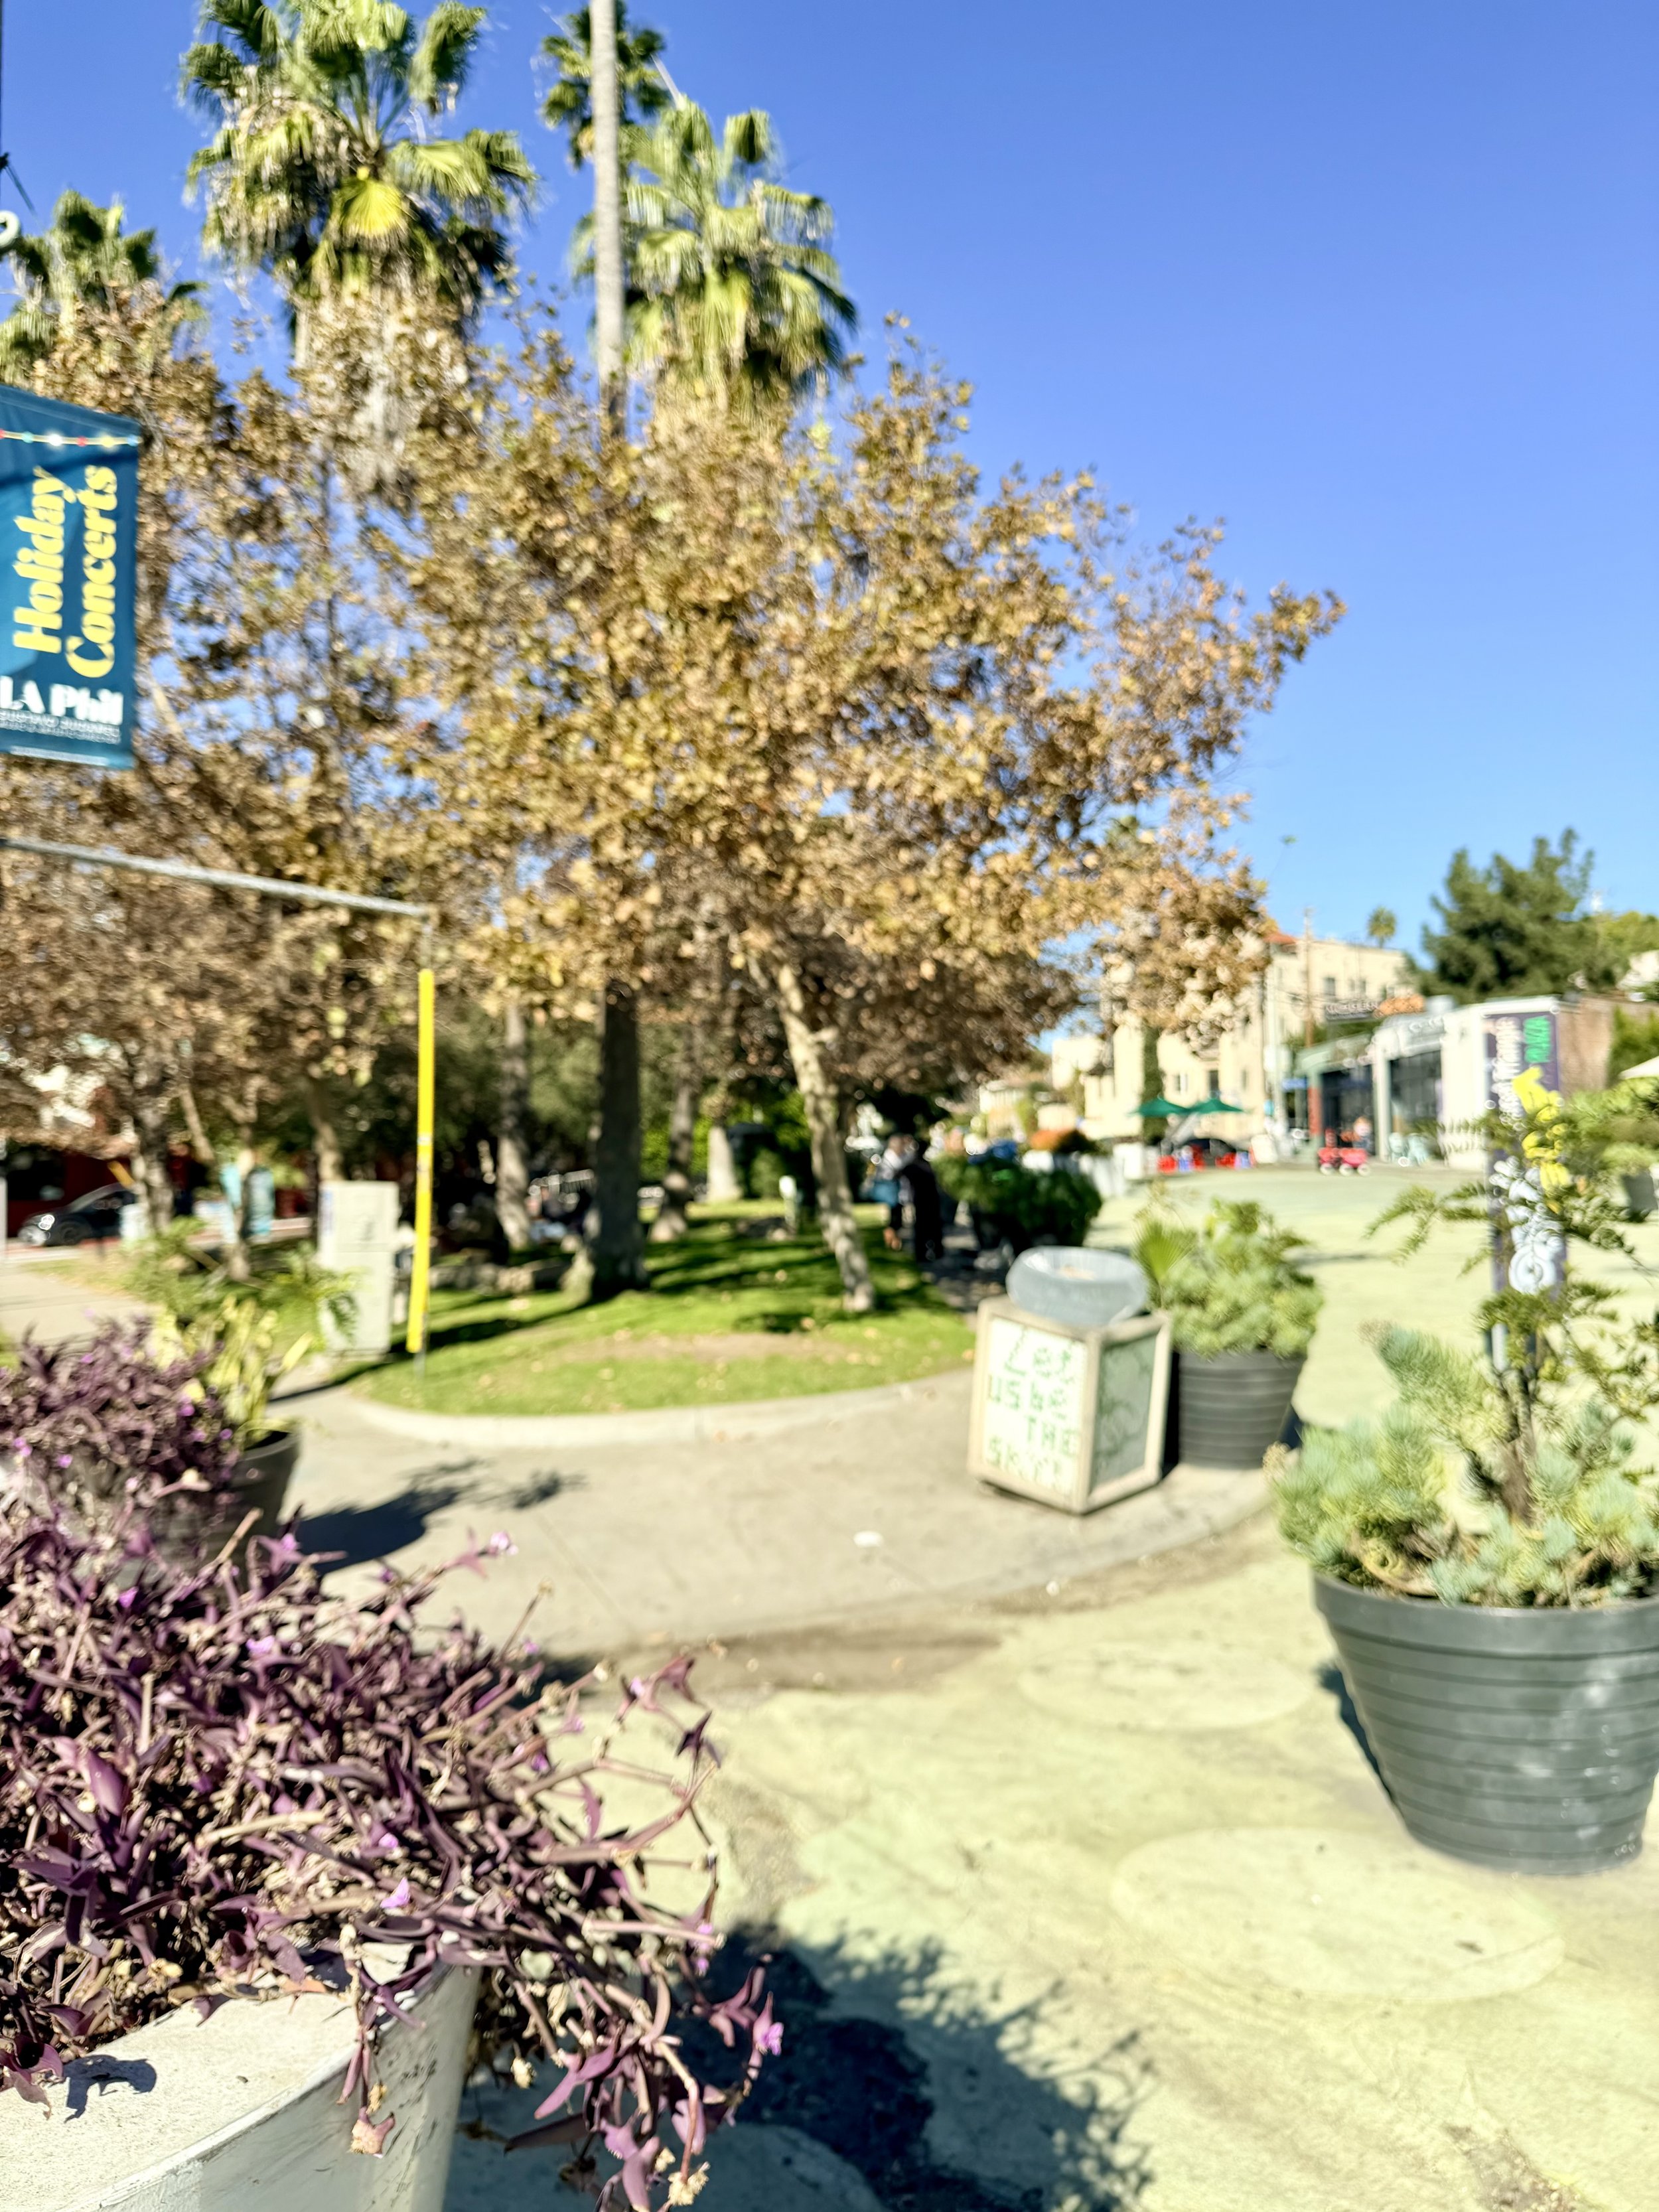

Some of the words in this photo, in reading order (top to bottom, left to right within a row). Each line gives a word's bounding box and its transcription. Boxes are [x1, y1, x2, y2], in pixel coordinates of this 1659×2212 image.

[13, 465, 77, 654] Holiday
[65, 465, 118, 678] Concerts
[0, 675, 45, 714] LA
[50, 684, 123, 725] Phil
[1025, 1414, 1082, 1458] THE
